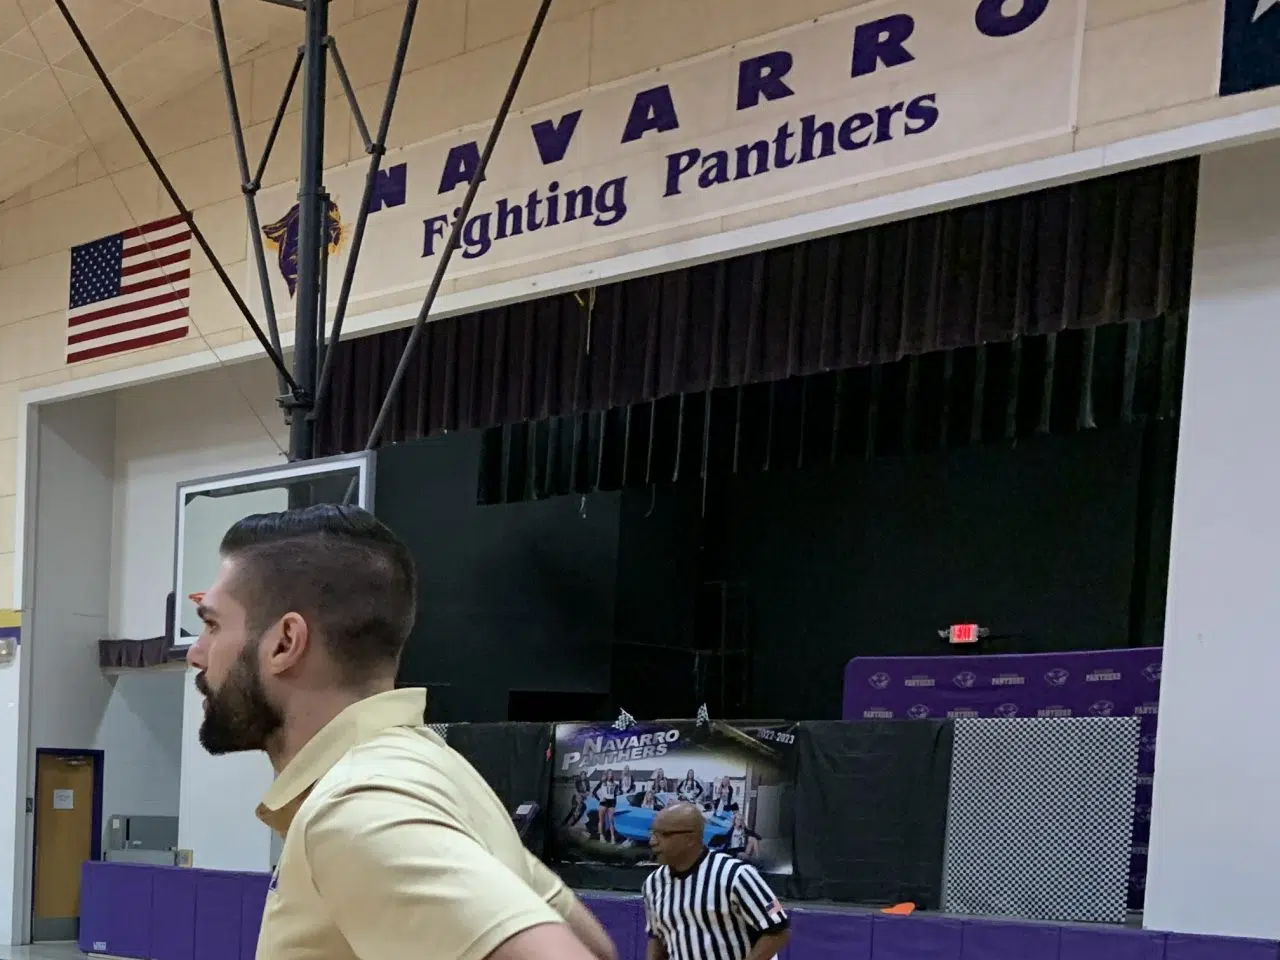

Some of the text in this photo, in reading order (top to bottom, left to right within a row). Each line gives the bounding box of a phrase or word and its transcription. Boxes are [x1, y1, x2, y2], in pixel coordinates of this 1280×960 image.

[366, 0, 1049, 214] NAVARRO
[421, 93, 939, 259] Fighting Panthers
[562, 743, 668, 771] PANTHERS
[582, 729, 680, 754] NAVARRO
